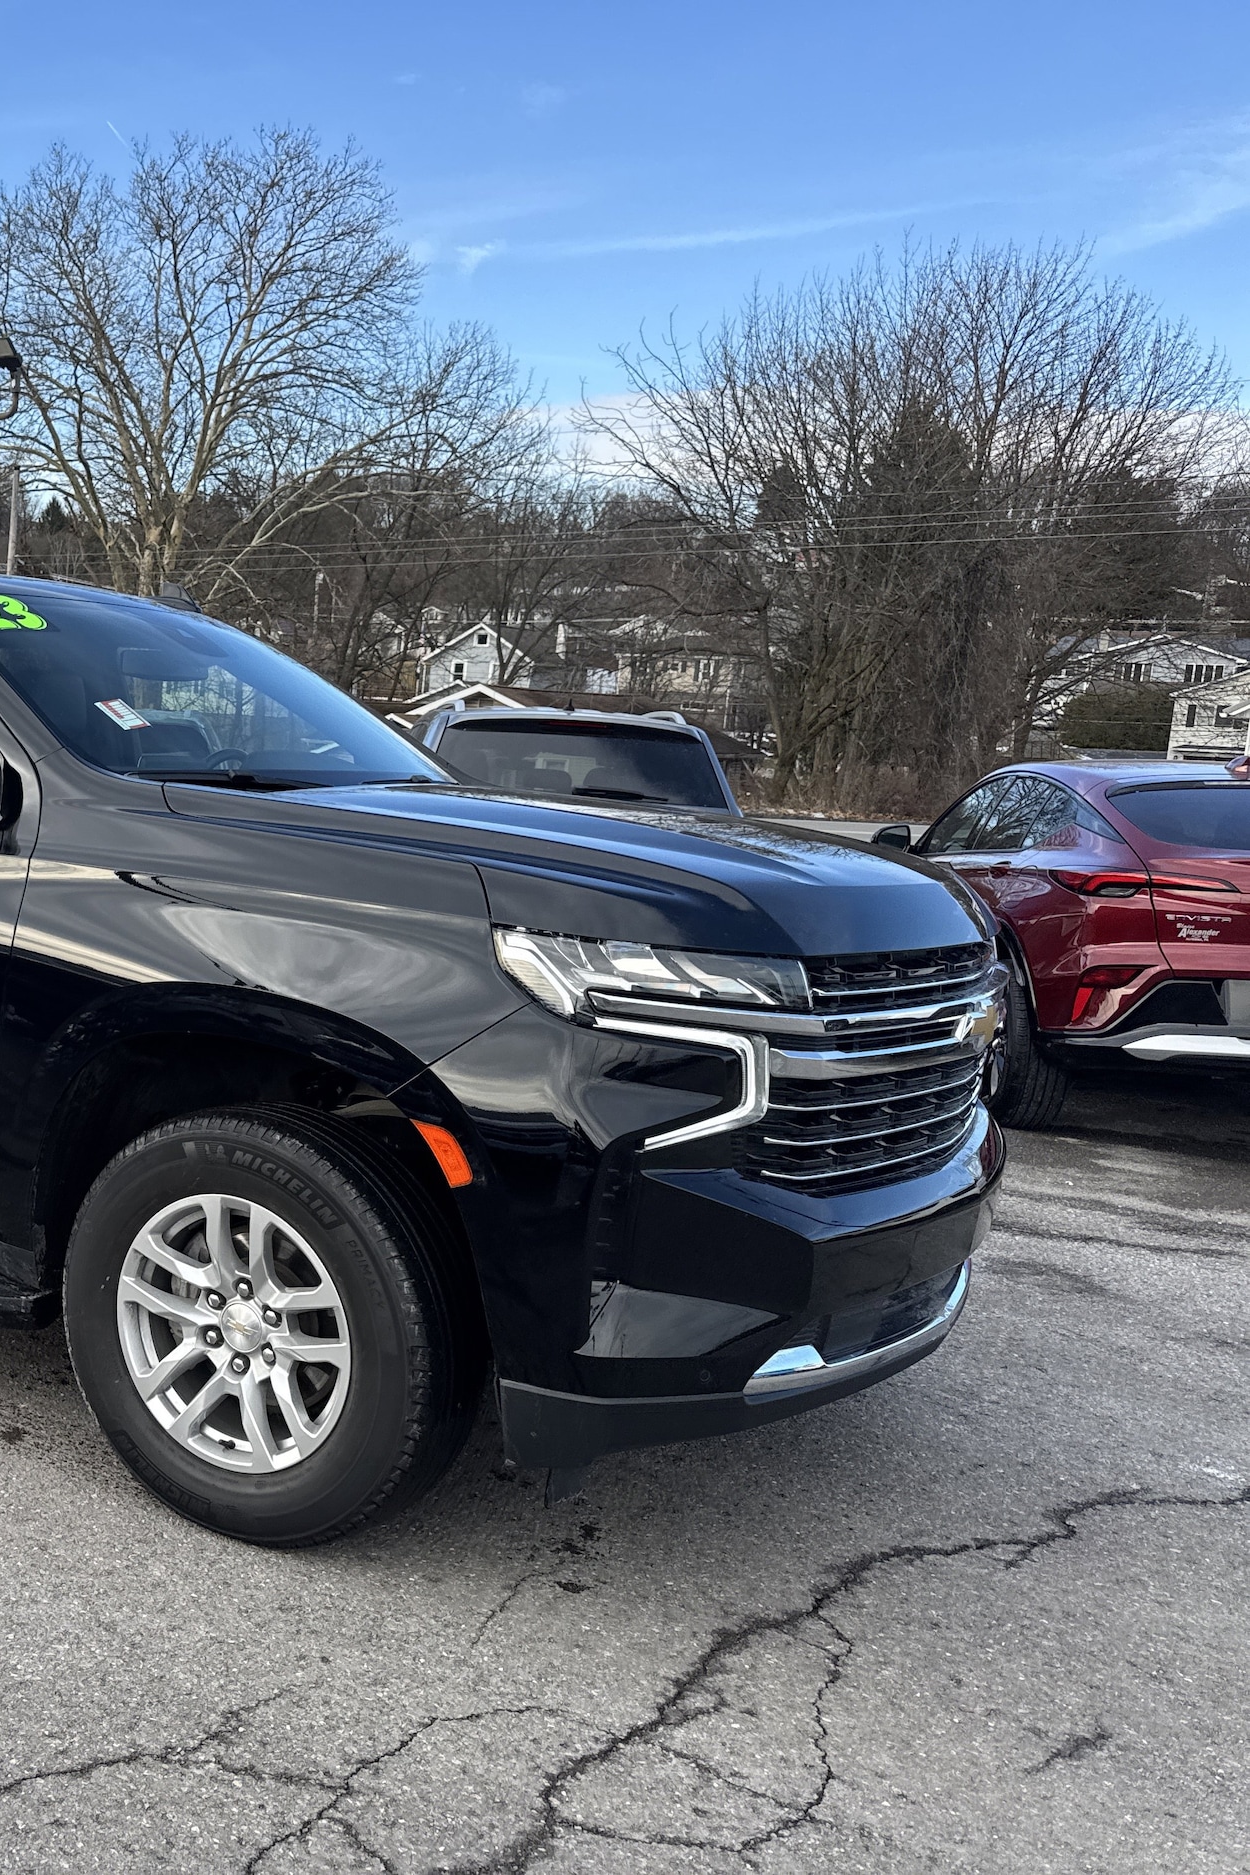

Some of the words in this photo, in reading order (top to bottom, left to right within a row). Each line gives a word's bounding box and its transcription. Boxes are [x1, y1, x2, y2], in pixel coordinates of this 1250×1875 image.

[1165, 913, 1232, 923] ENVISTA
[1177, 928, 1221, 938] Alexander
[231, 1149, 338, 1226] MICHELIN
